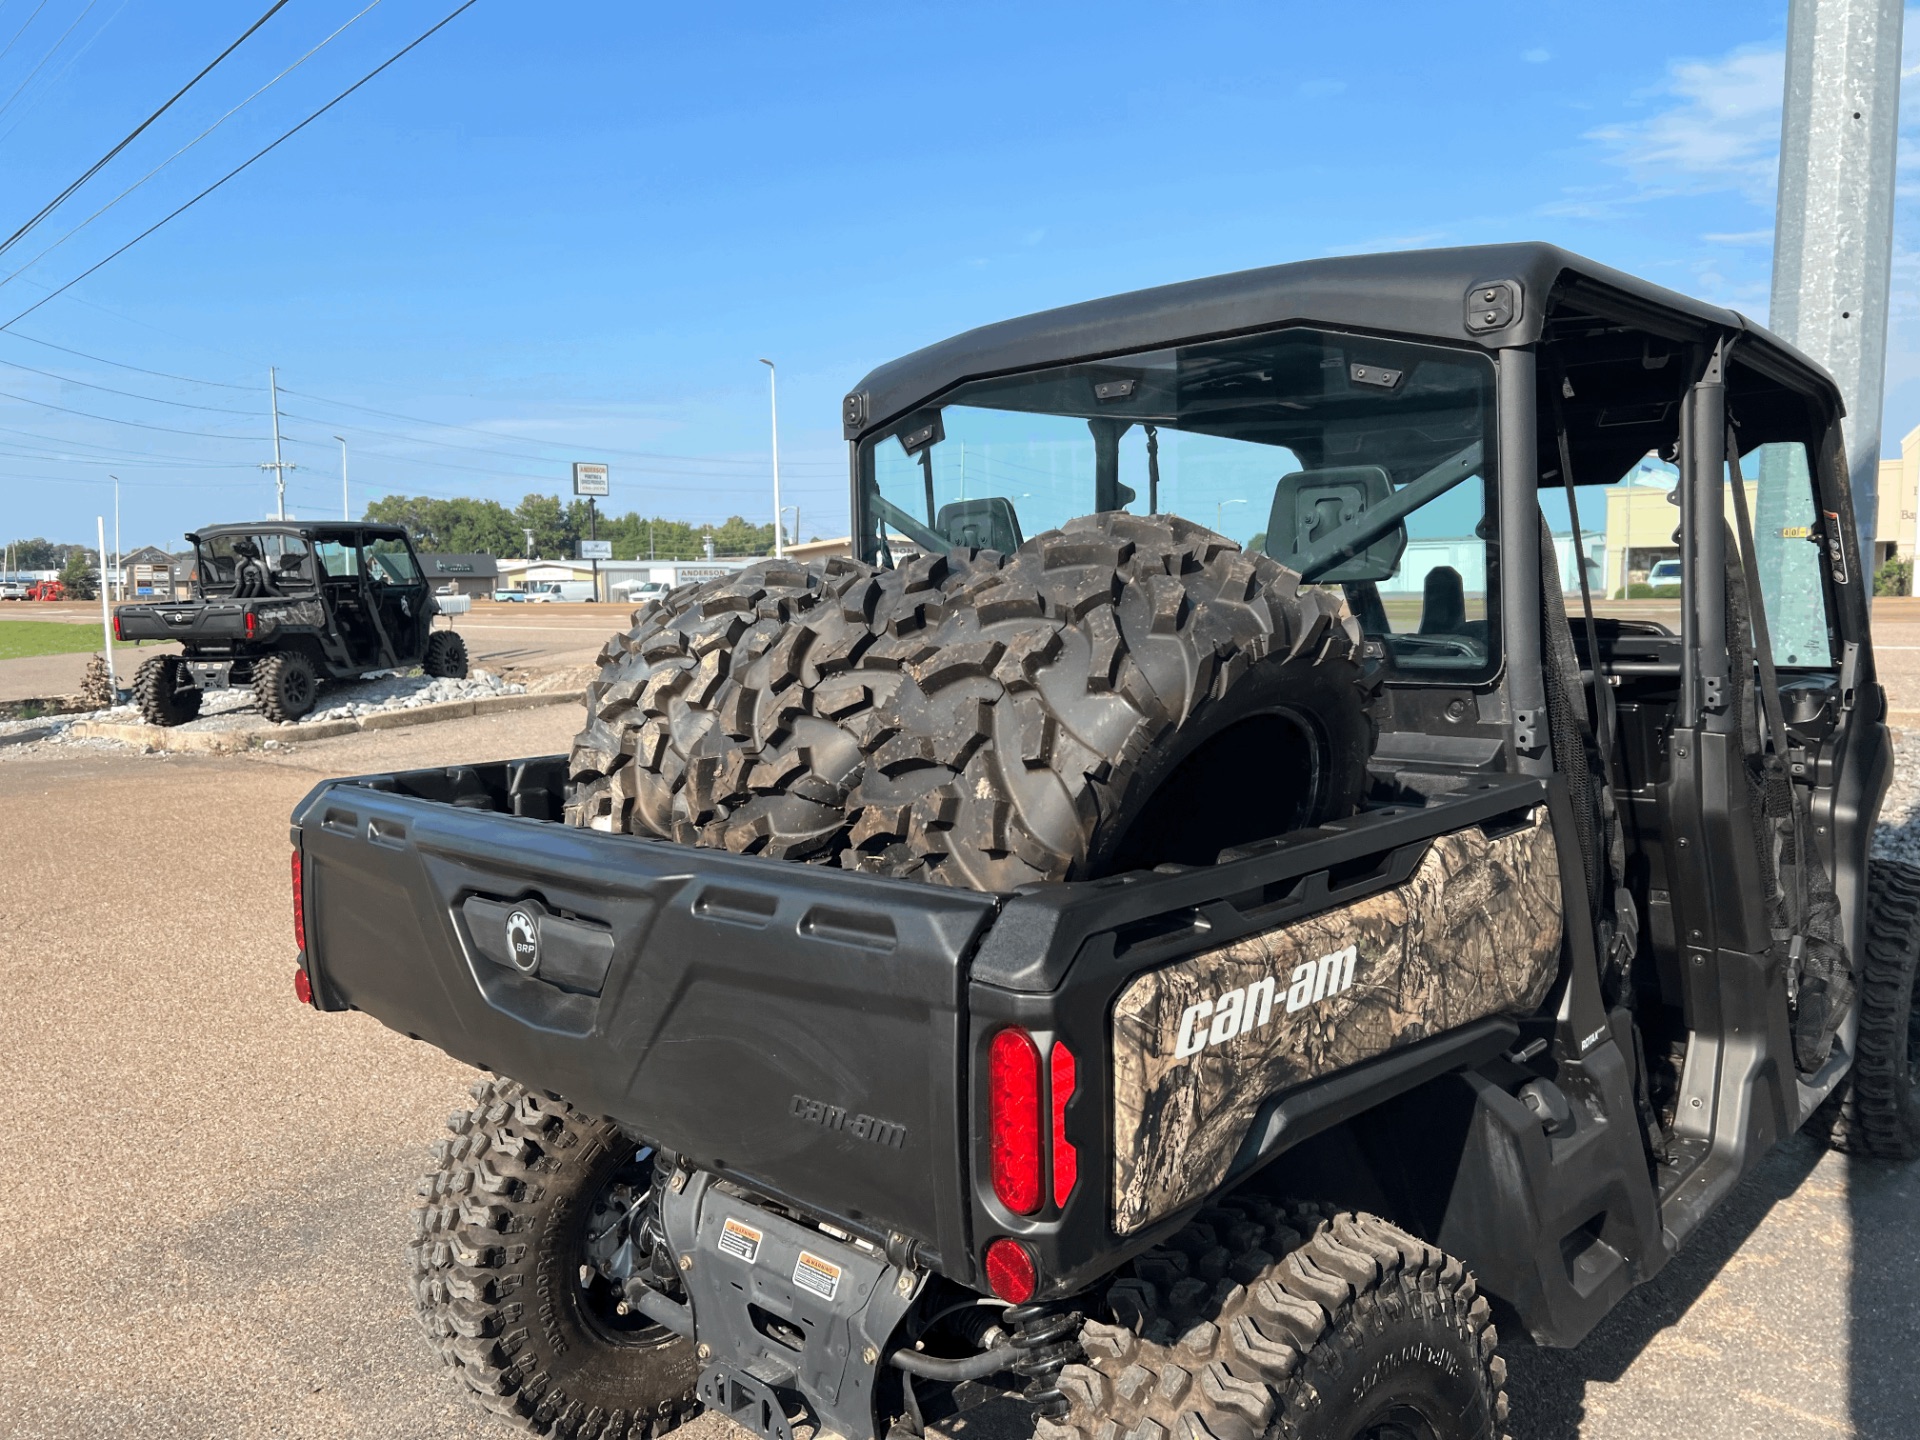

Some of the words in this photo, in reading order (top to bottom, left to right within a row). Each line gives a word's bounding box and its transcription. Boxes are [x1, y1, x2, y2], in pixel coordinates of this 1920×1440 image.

[580, 466, 606, 474] ANDERSON
[516, 943, 535, 953] BRP
[1174, 944, 1358, 1060] can-am
[788, 1094, 907, 1150] can-am
